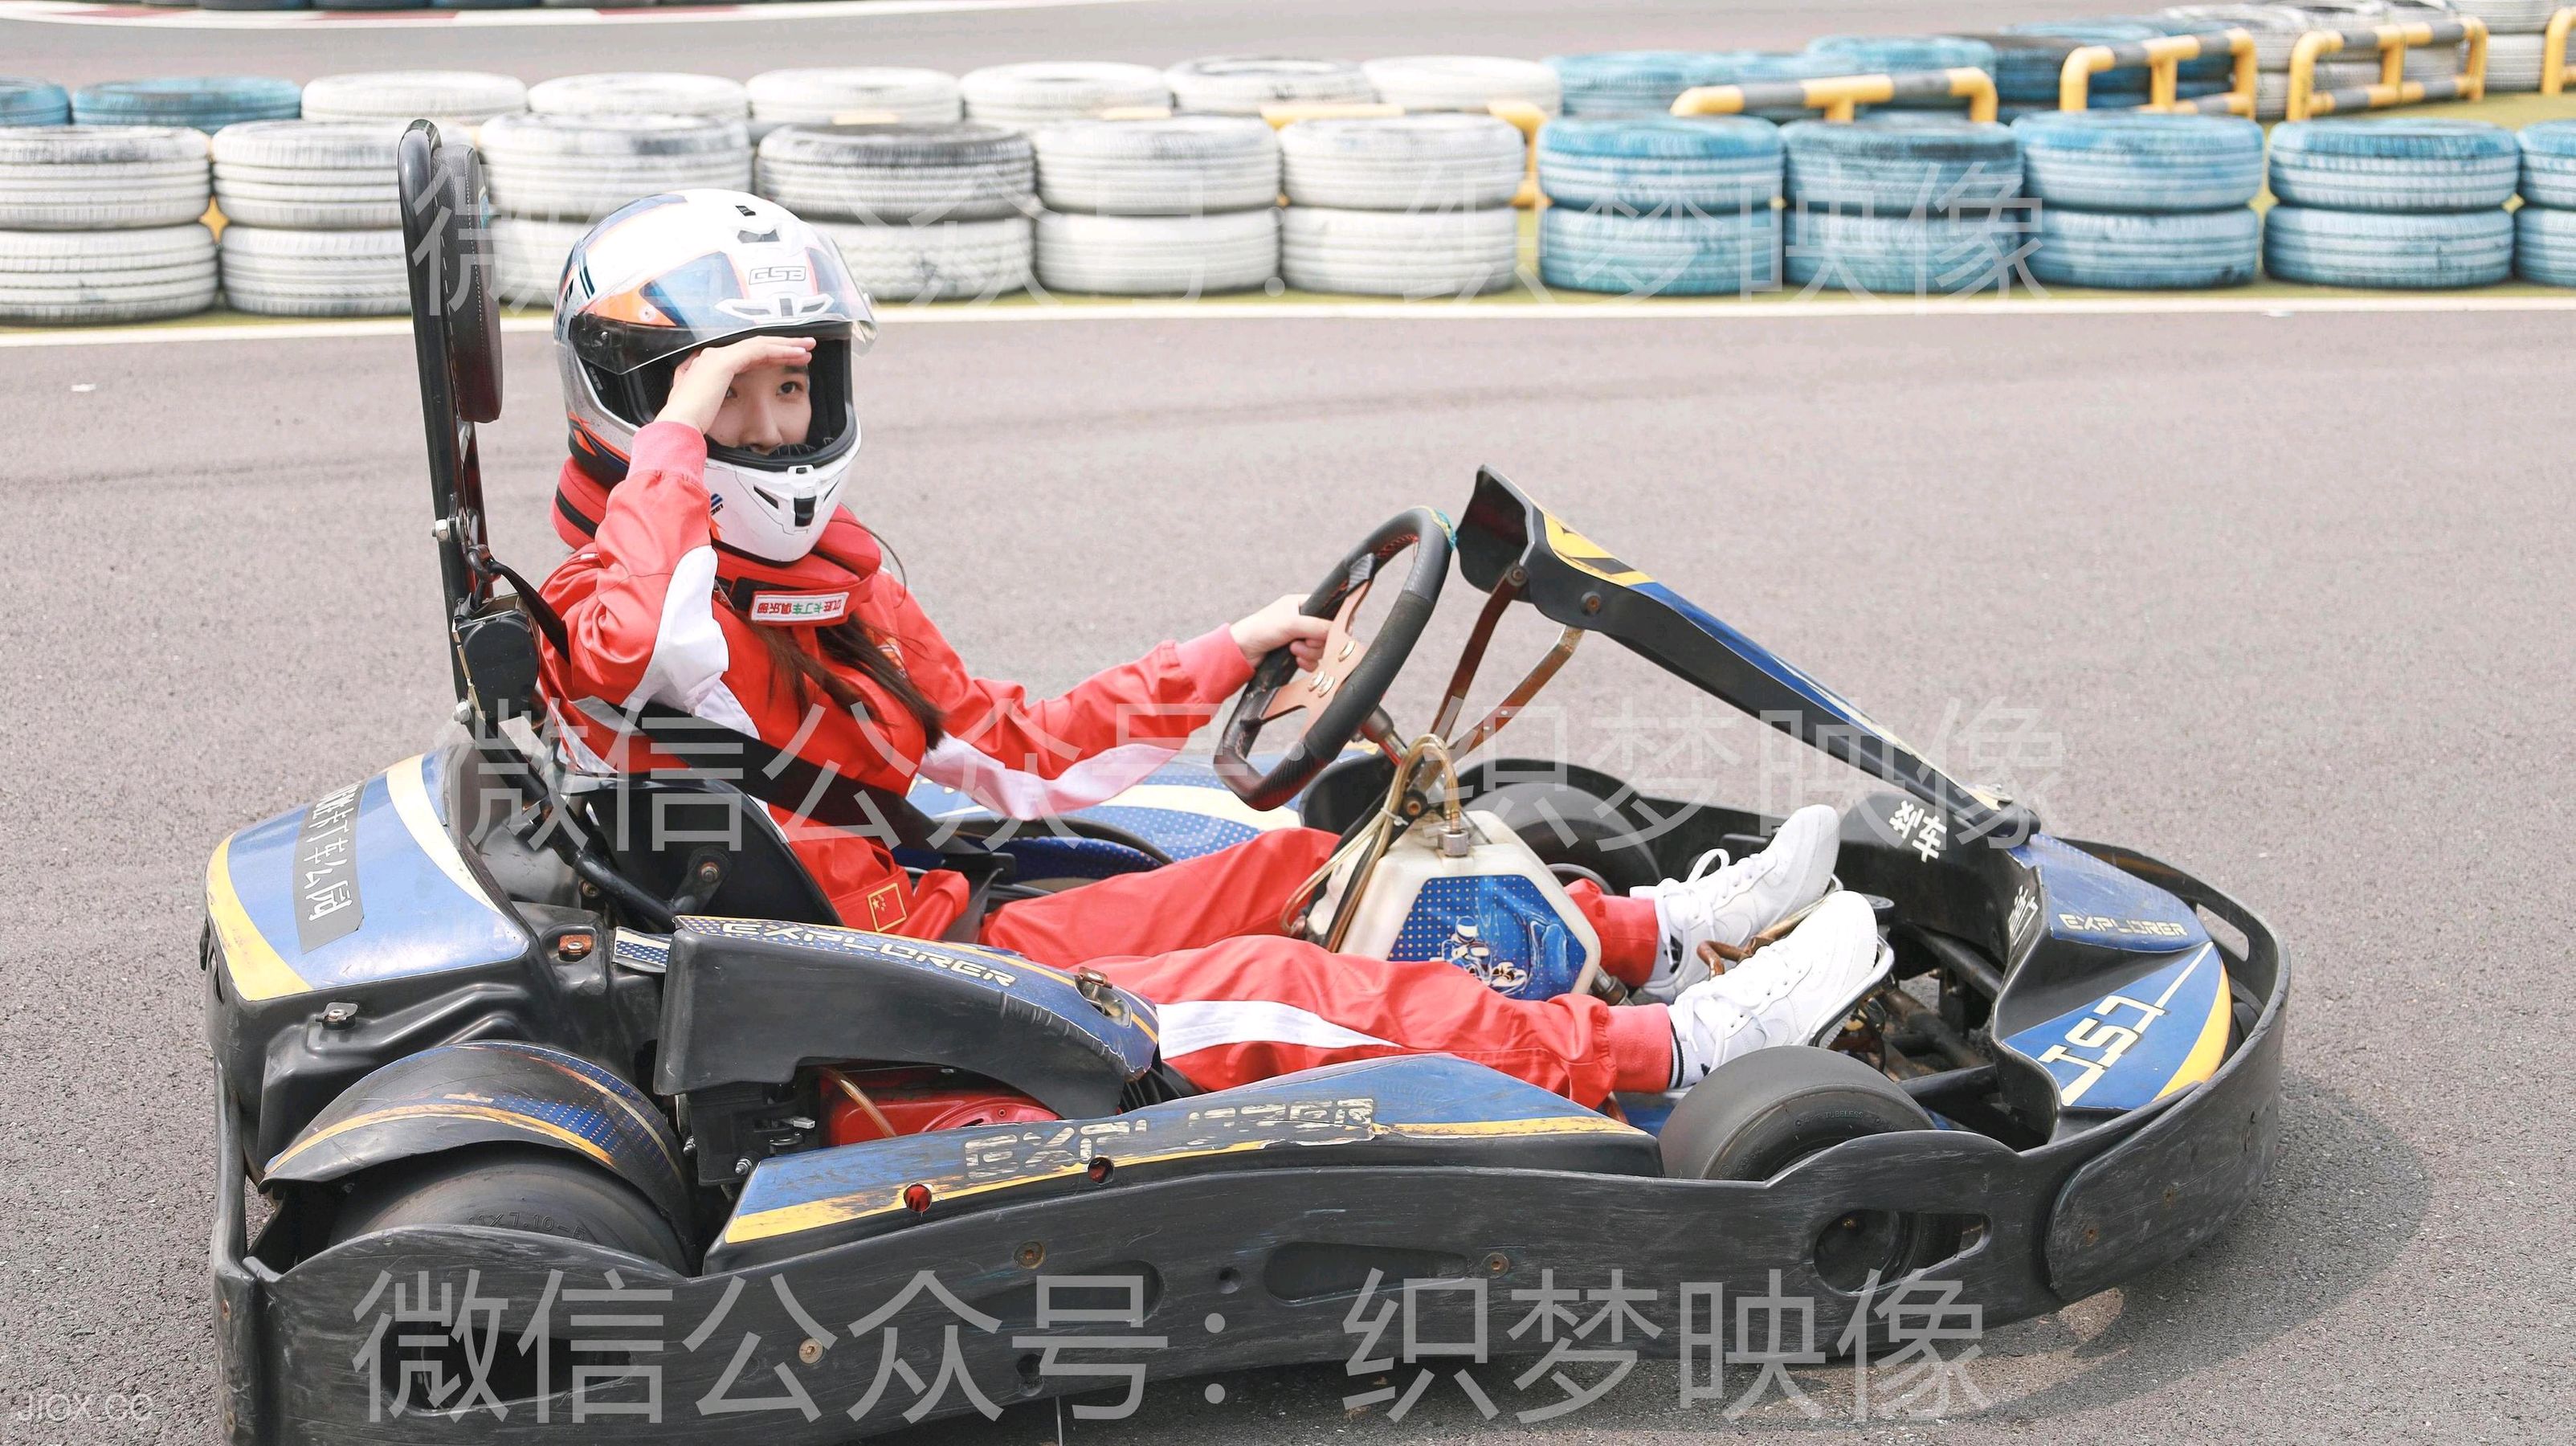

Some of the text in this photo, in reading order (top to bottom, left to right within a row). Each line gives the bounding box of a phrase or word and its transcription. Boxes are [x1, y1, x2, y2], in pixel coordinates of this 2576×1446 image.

[748, 265, 806, 285] GSB
[1889, 799, 1947, 864] 刹车
[2058, 913, 2188, 937] EXPLORER
[722, 921, 1017, 988] EXPLORER
